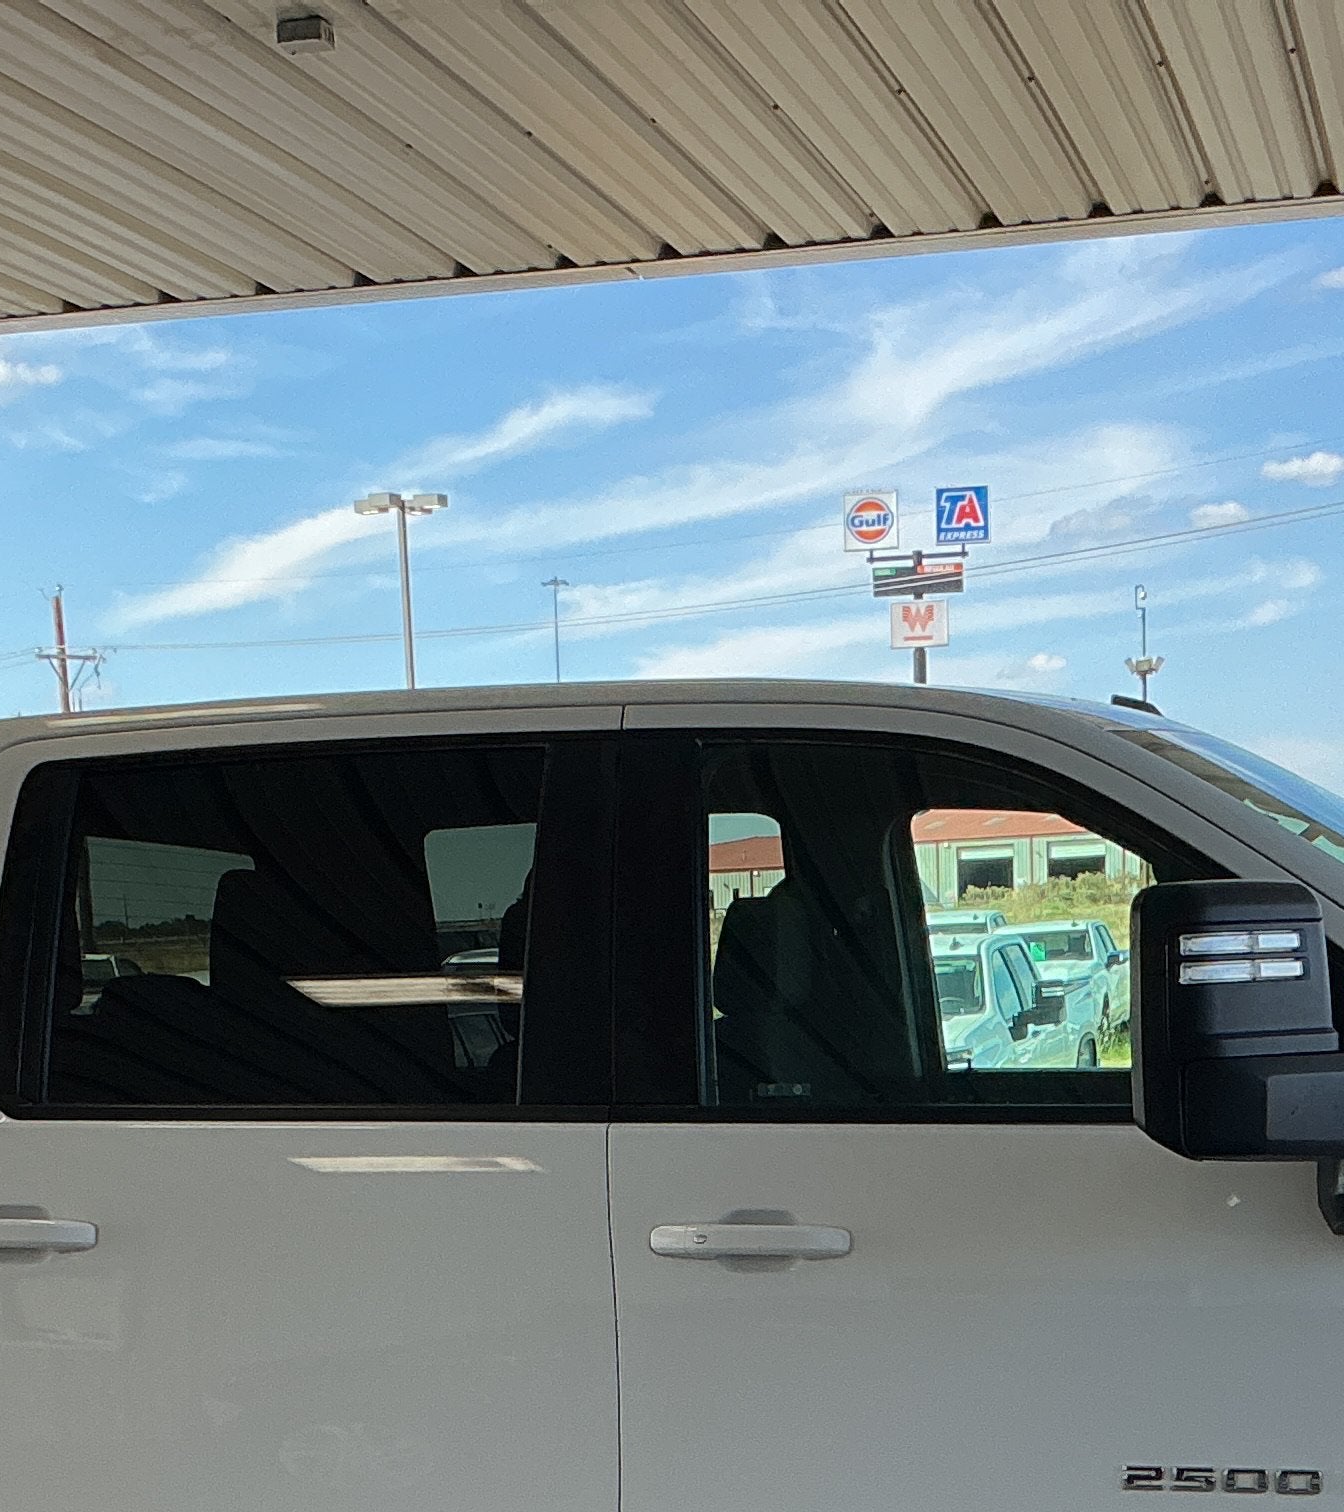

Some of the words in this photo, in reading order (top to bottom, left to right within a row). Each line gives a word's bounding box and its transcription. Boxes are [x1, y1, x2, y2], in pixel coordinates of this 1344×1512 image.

[941, 491, 984, 528] TA
[850, 514, 890, 529] Gulf
[939, 530, 984, 541] EXPRESS
[1121, 1464, 1323, 1495] 2500
